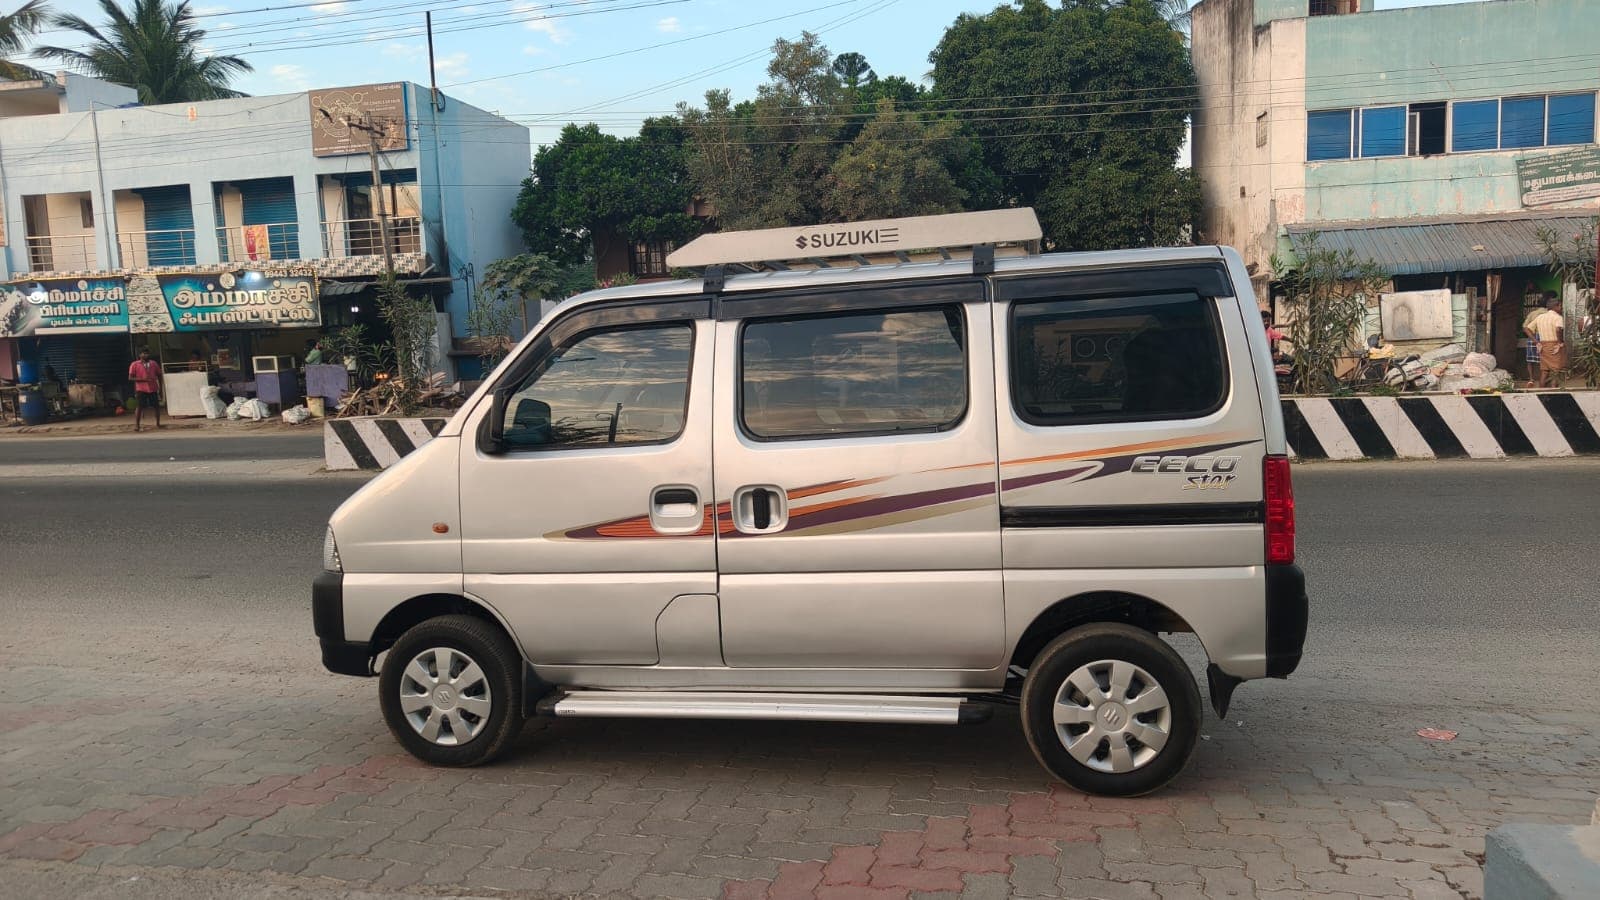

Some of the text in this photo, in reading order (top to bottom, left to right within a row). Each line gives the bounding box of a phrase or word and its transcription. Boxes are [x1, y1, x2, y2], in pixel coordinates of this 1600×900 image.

[811, 229, 879, 249] SUZUKI
[173, 280, 314, 309] அம்மாச்சி
[40, 302, 120, 318] பிரியாணி
[1130, 455, 1241, 473] EECO
